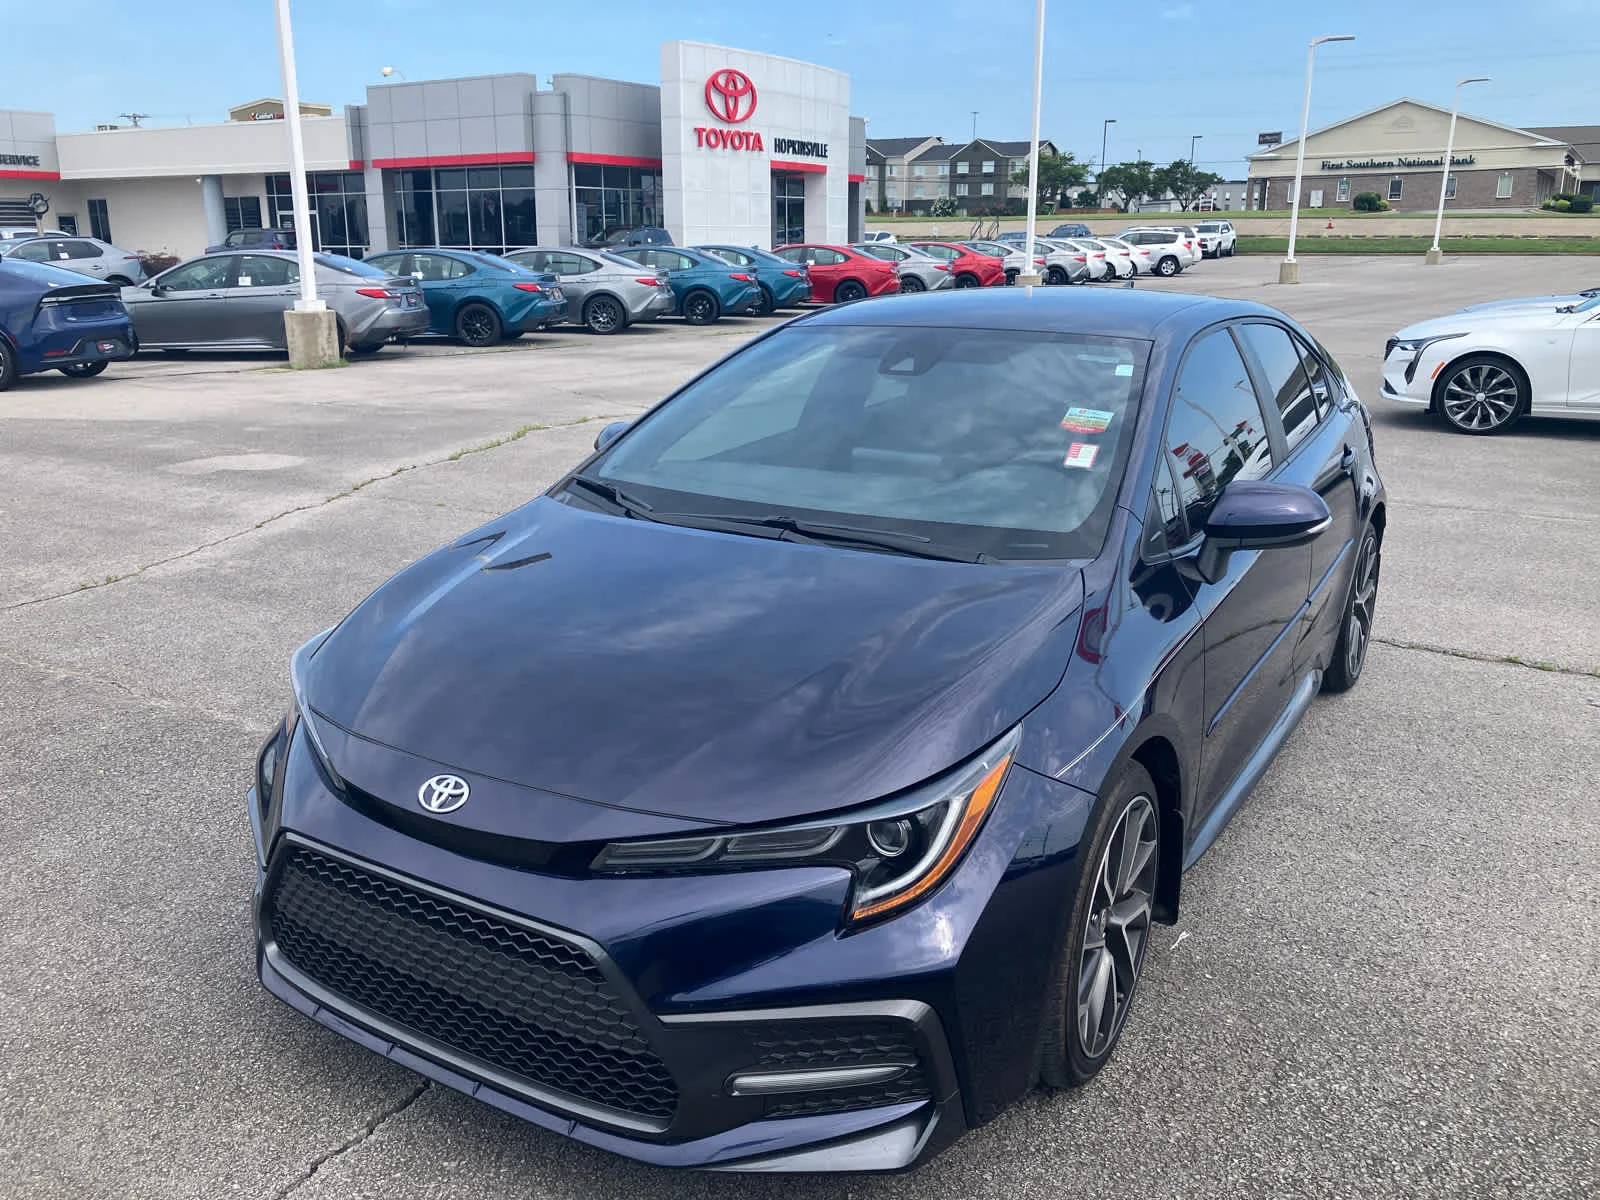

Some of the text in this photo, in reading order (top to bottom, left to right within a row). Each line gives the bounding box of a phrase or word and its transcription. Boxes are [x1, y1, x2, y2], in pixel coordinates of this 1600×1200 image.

[694, 127, 765, 152] TOYOTA
[774, 137, 829, 158] HOPKINSVILLE
[1321, 154, 1475, 170] First Southern National Bank
